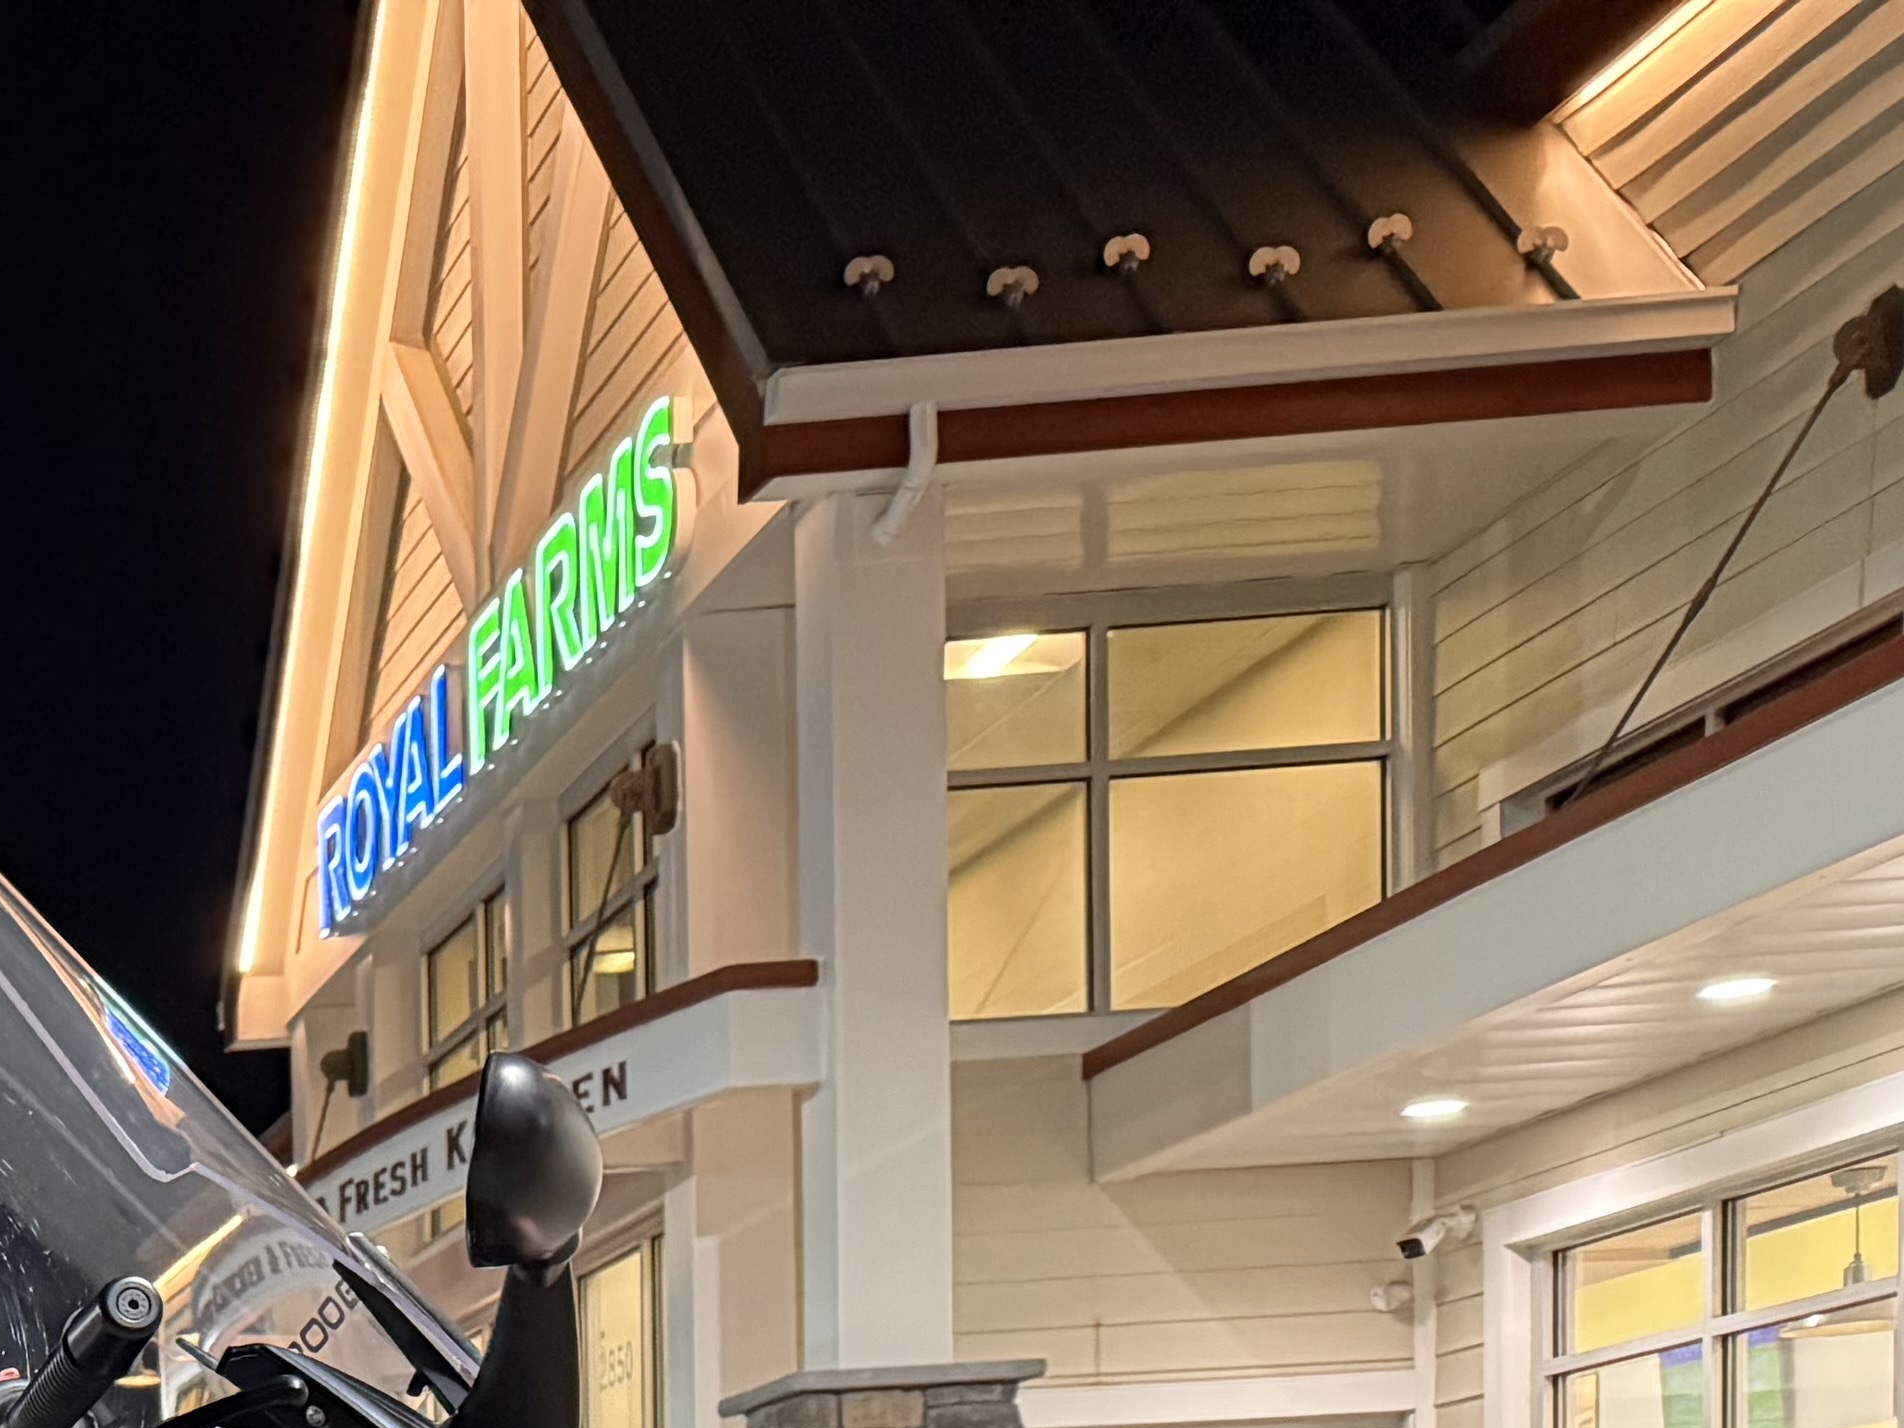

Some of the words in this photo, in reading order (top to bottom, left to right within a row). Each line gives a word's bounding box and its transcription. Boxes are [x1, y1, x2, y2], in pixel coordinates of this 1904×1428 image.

[317, 664, 463, 938] ROYAL
[468, 395, 673, 775] FARMS
[339, 1148, 428, 1223] FRESH
